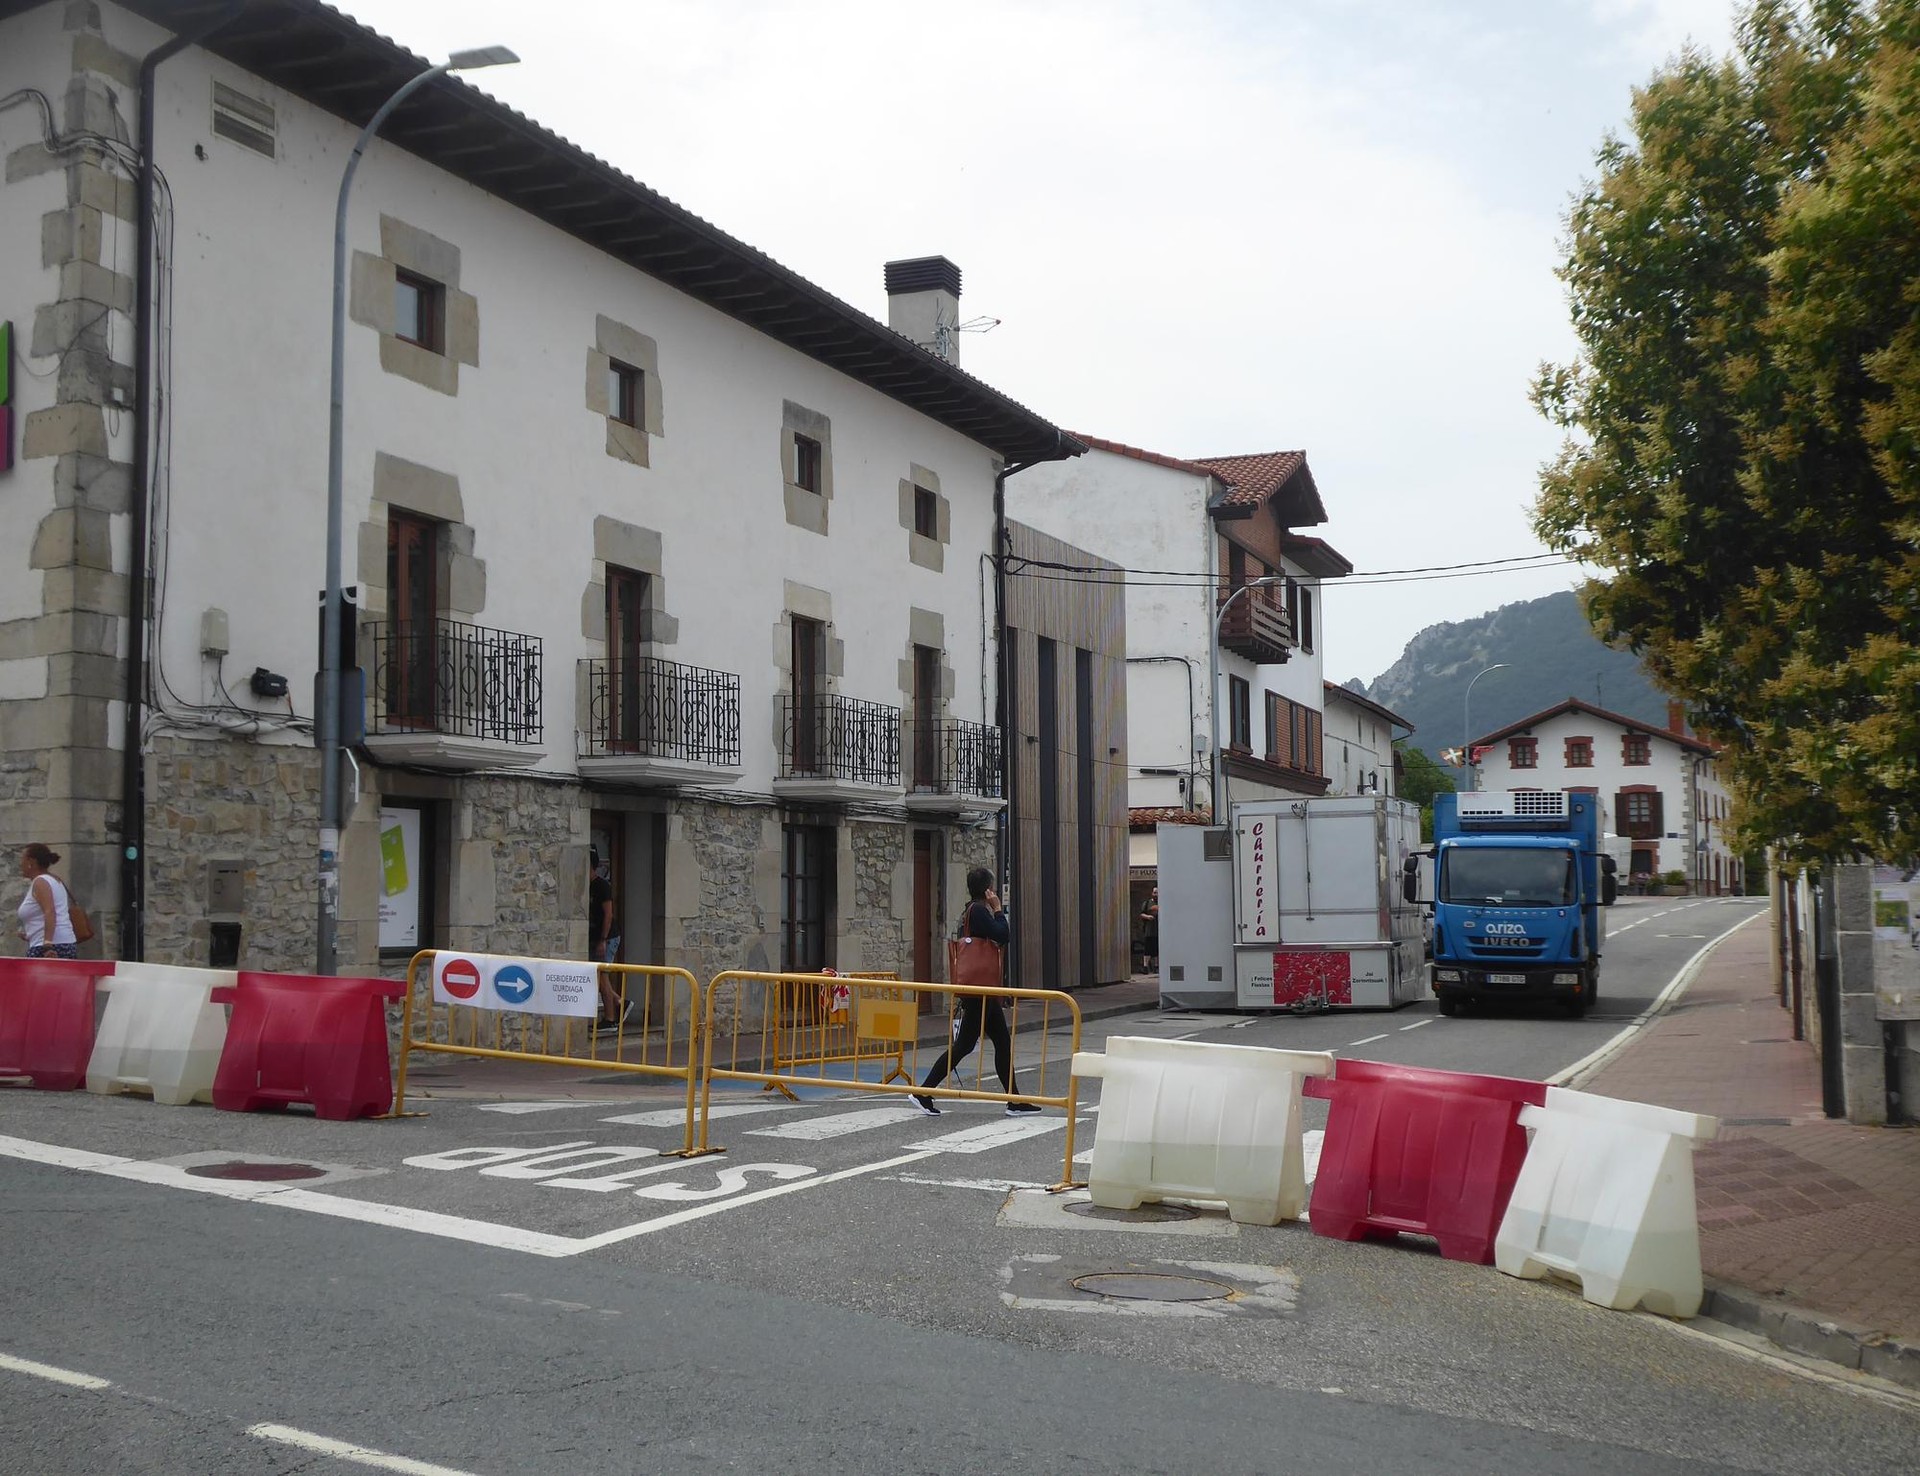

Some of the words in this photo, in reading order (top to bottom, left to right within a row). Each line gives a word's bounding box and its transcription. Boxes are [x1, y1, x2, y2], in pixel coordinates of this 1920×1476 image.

[1485, 921, 1527, 934] ariza
[1484, 937, 1530, 947] IVECO
[545, 973, 592, 984] DESBIDERATZEA
[558, 994, 579, 1003] DESVIO
